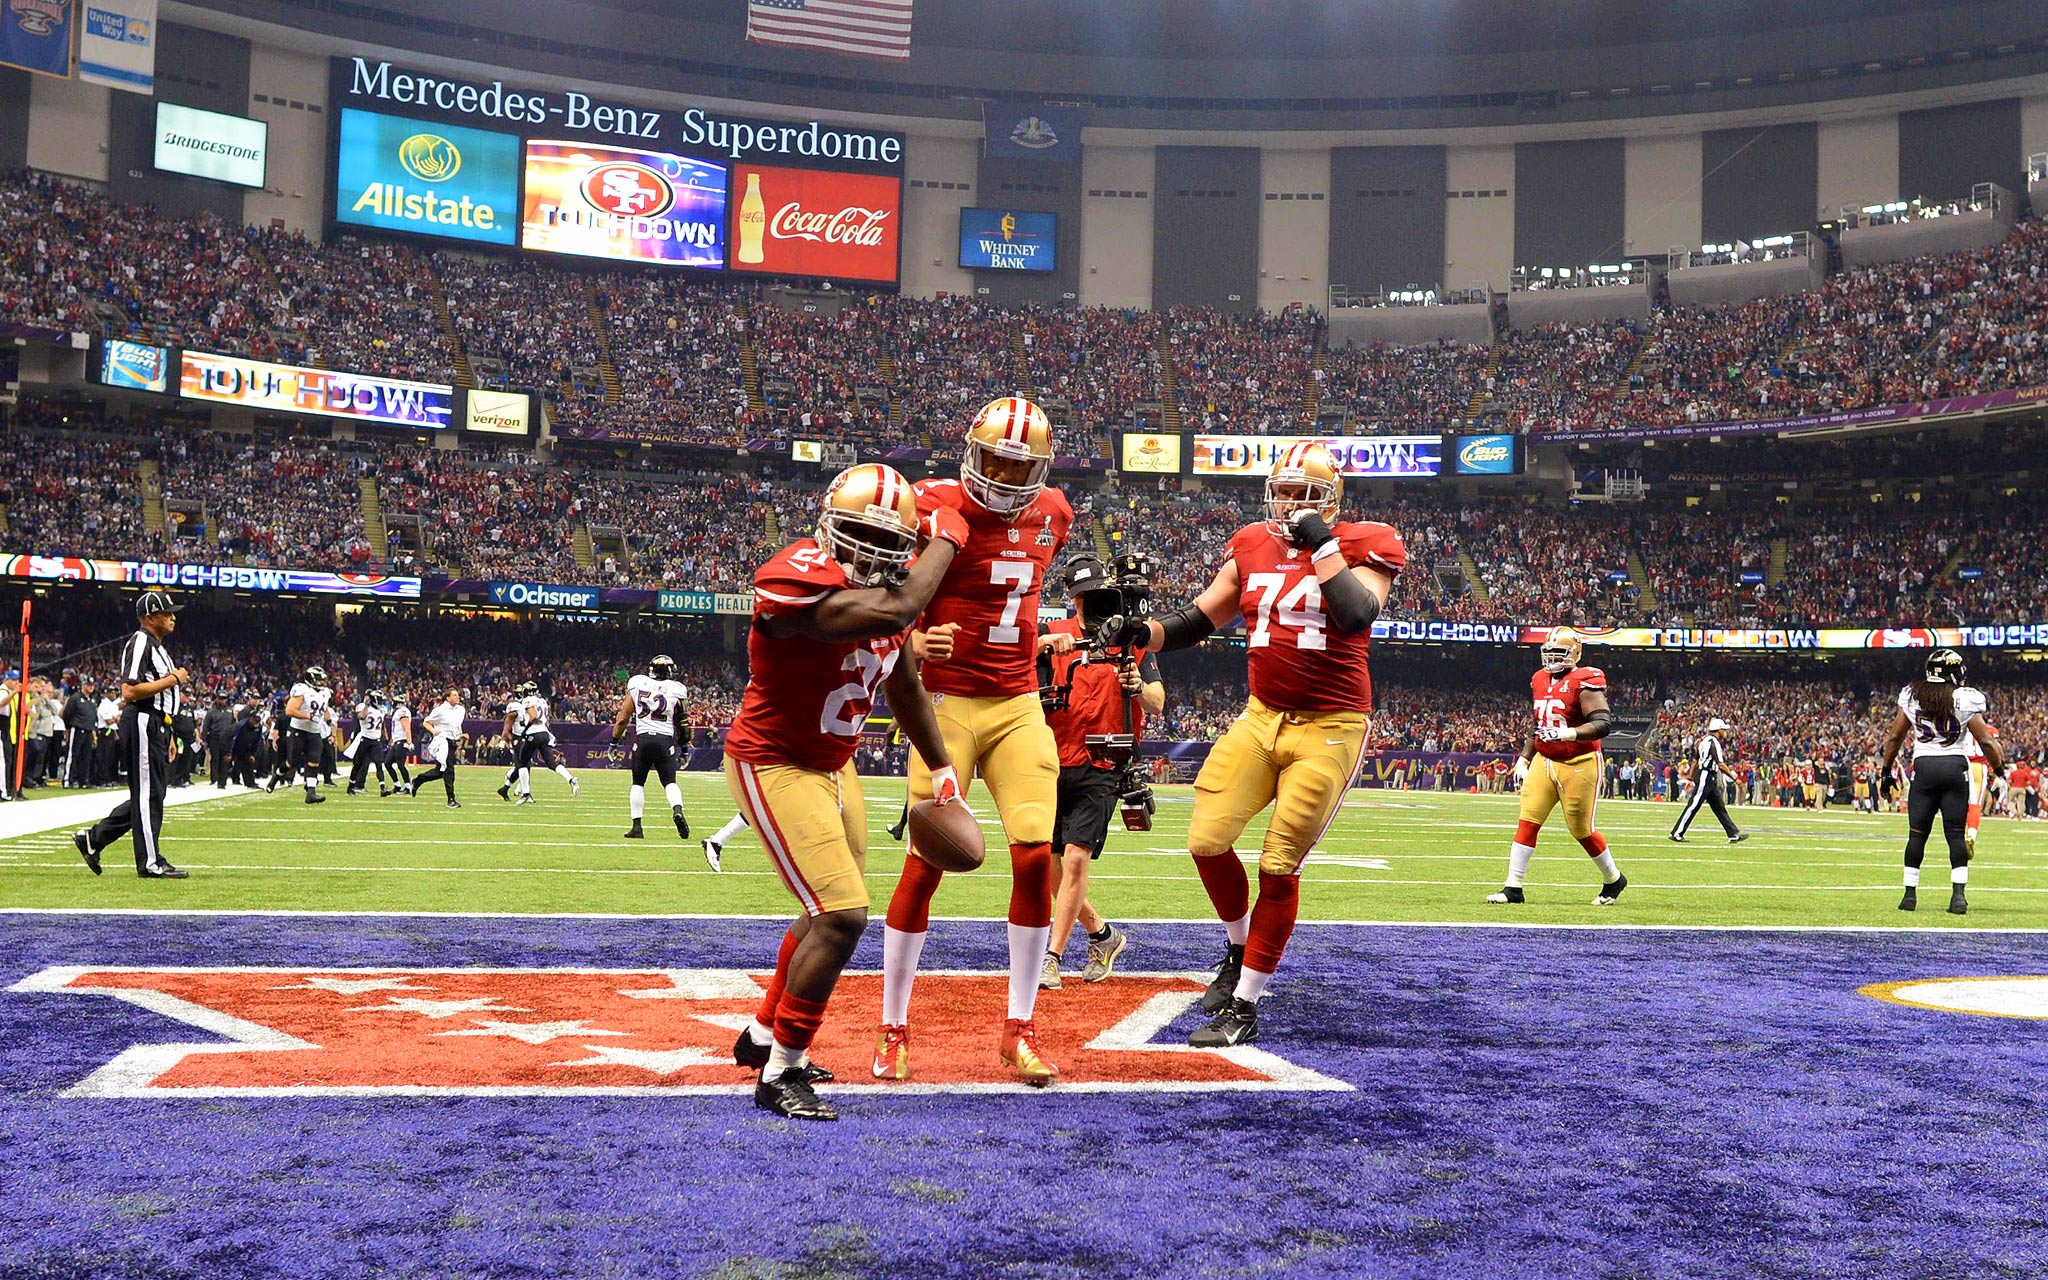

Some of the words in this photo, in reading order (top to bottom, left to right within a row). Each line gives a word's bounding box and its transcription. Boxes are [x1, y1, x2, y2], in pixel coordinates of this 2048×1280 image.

[88, 10, 123, 26] United
[101, 24, 122, 39] Way
[349, 57, 662, 139] Mercedes-Benz
[682, 108, 900, 163] Superdome
[165, 132, 260, 161] BRIDGESTONE
[352, 181, 495, 230] Allstate
[770, 202, 891, 247] Coca-Cola
[979, 240, 1037, 256] WHITNEY
[991, 254, 1025, 269] BANK
[804, 304, 817, 313] 627
[115, 351, 158, 369] LIGHT
[122, 343, 157, 360] BUD
[473, 414, 521, 429] verizon
[608, 430, 634, 440] SAN
[637, 433, 705, 446] FRANCISCO
[1203, 443, 1415, 469] TOUDOWN
[1468, 453, 1509, 462] LIGHT
[1474, 446, 1508, 454] BUD
[790, 547, 829, 567] 21
[509, 583, 590, 607] Ochsner
[660, 594, 712, 610] PEOPLES
[988, 560, 1035, 644] 7
[1246, 572, 1327, 651] 74
[638, 690, 668, 722] 52
[1533, 699, 1568, 729] 76
[366, 715, 382, 730] 32
